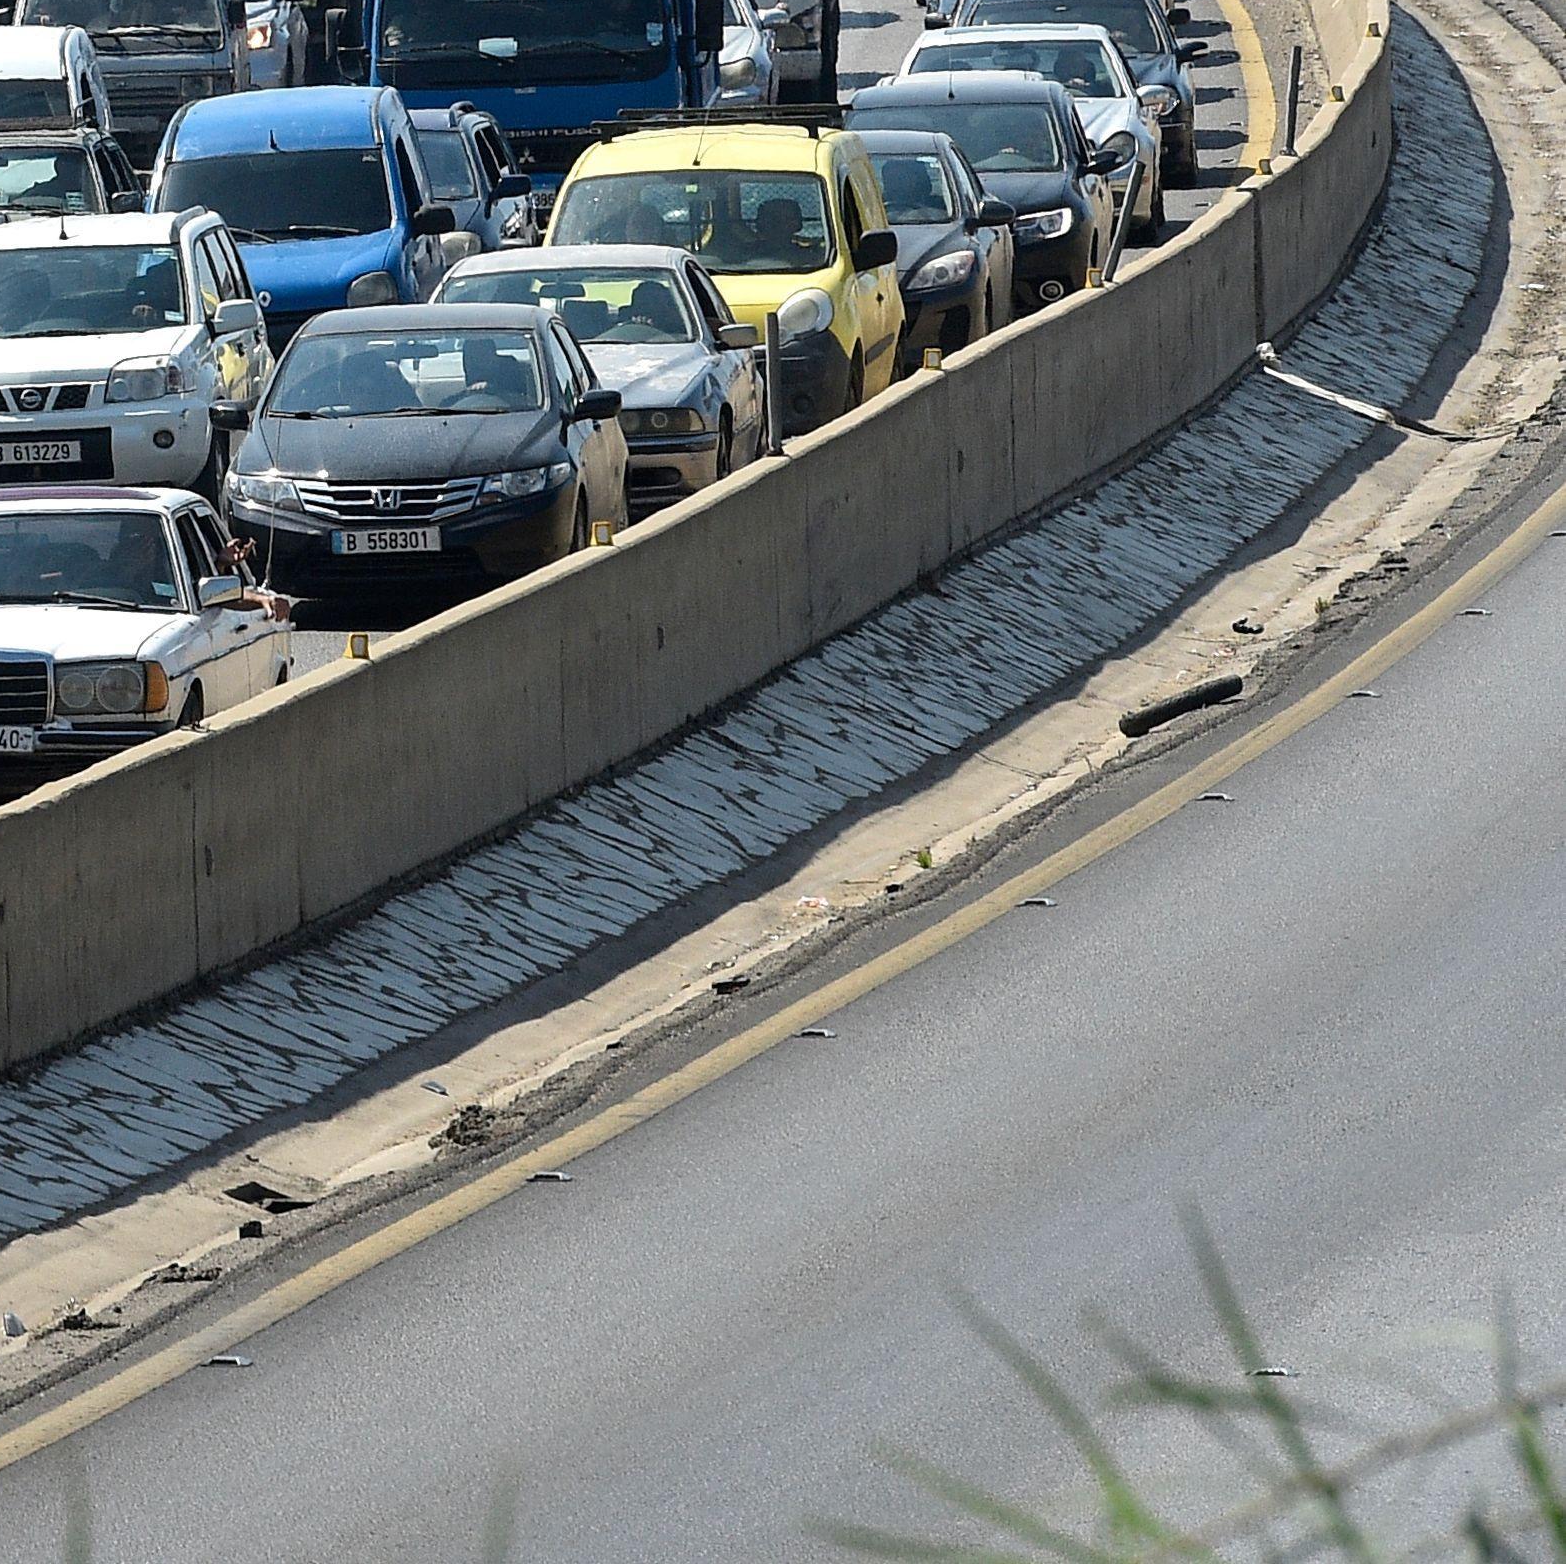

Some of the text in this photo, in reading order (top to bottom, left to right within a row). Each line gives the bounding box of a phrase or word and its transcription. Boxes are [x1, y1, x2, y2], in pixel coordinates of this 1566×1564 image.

[552, 127, 602, 136] FUSO
[13, 443, 70, 462] 613229
[347, 530, 428, 551] B 558301
